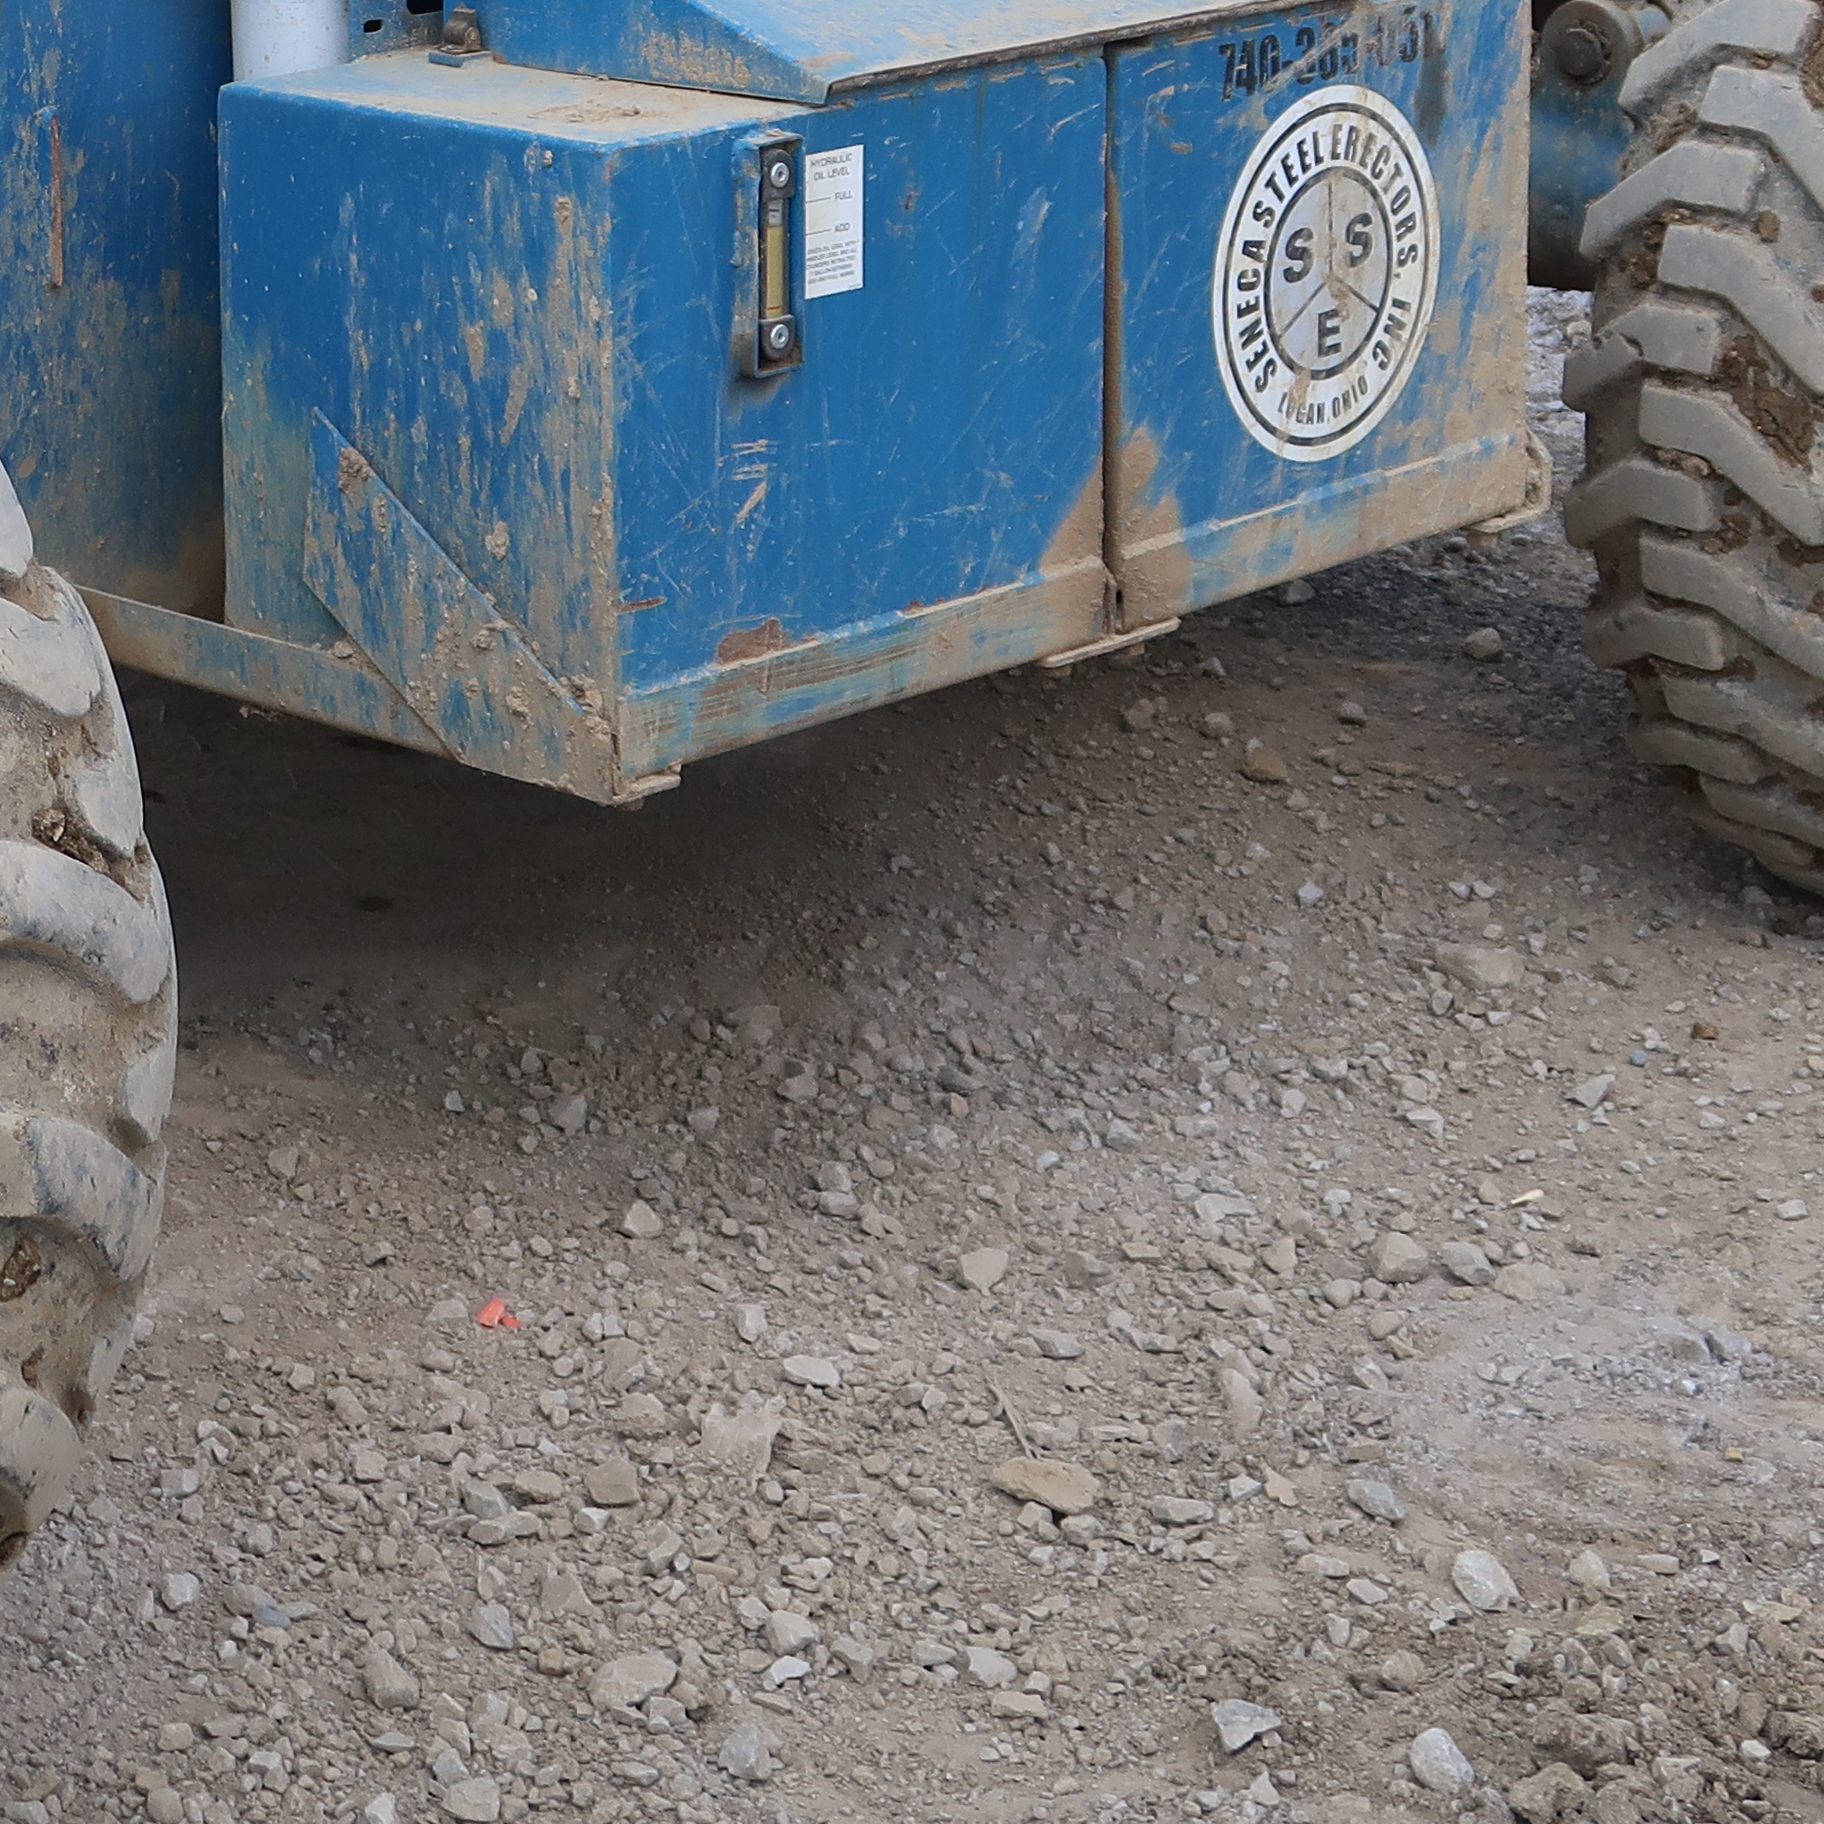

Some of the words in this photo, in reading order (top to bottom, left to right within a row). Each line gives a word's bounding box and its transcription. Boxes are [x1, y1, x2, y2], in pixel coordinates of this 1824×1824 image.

[810, 152, 853, 168] HYDRAULIC
[813, 170, 826, 181] OIL
[828, 167, 850, 179] LEVEL
[1253, 131, 1325, 228] STEEL
[834, 190, 853, 201] FULL
[834, 222, 851, 233] ADD
[1237, 239, 1277, 393] SENECA
[1331, 374, 1369, 420] OHIO
